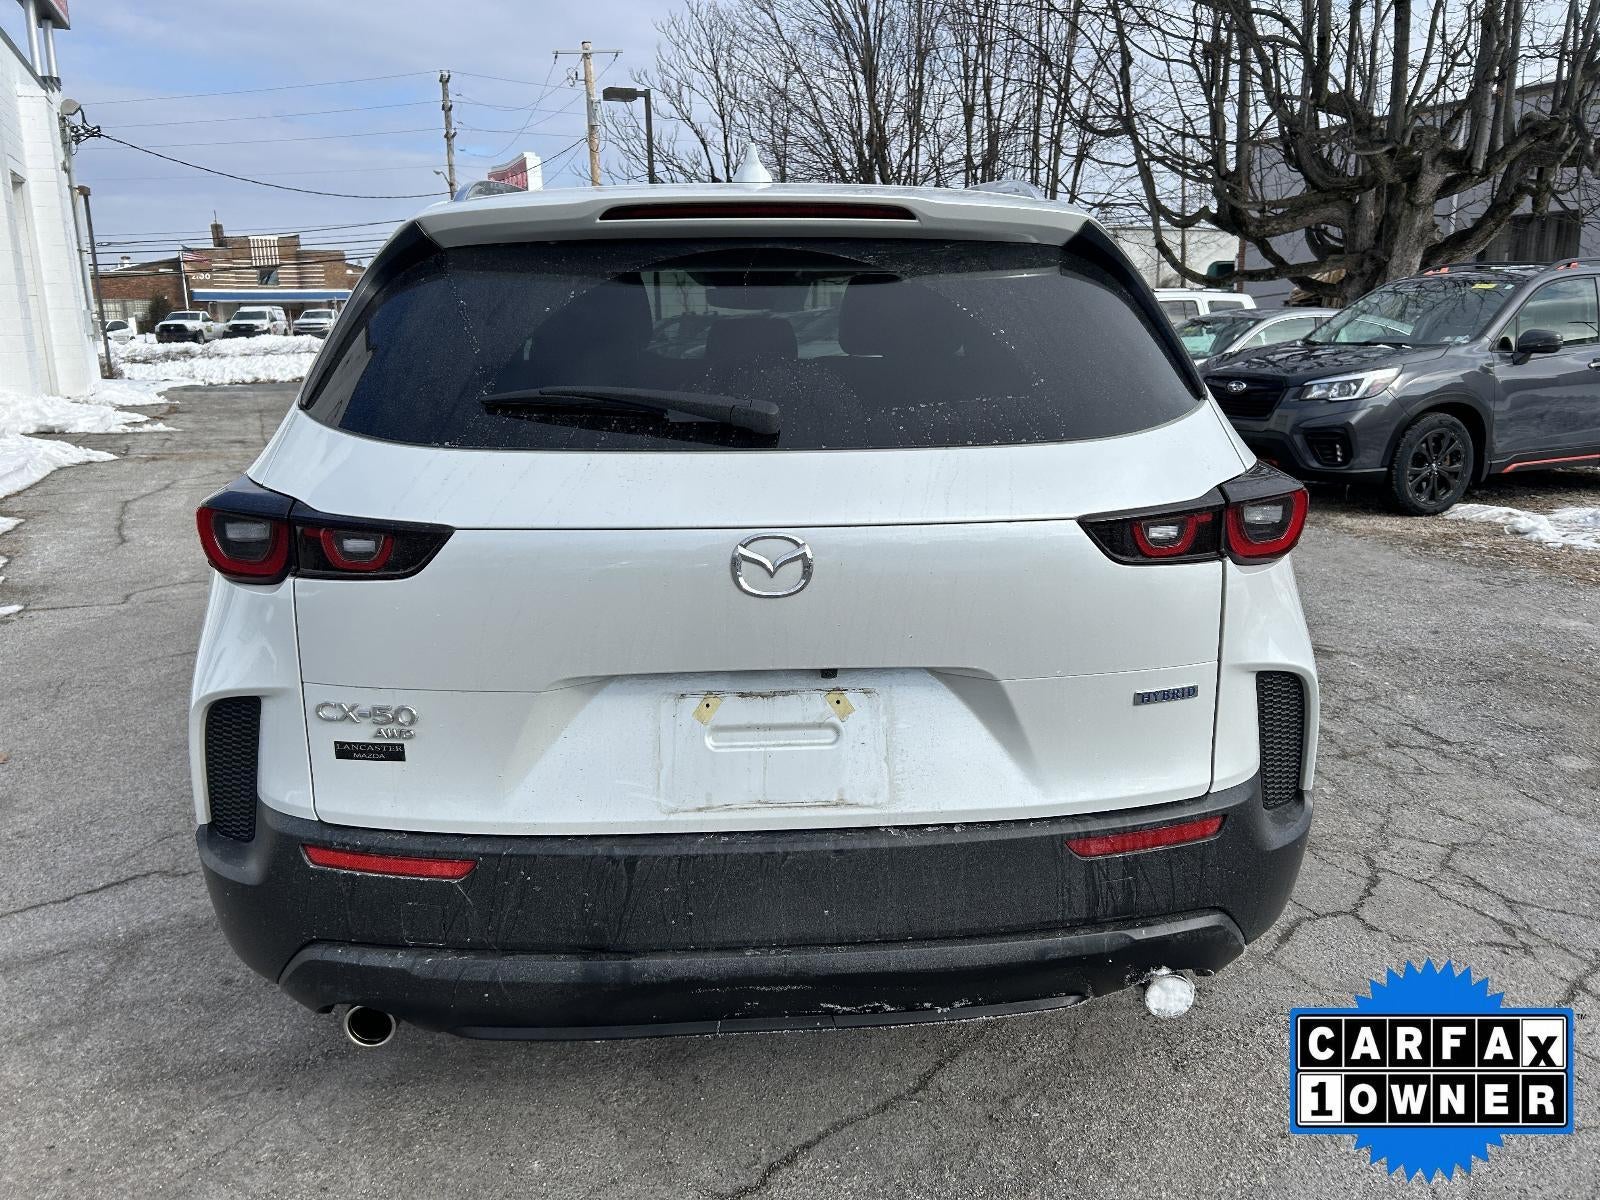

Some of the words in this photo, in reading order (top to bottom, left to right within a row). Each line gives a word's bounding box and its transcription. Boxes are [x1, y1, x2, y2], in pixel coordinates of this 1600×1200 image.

[1141, 686, 1196, 703] HYBRID
[315, 702, 418, 727] CX-50
[373, 727, 416, 740] AWD
[336, 743, 403, 752] LANCASTER
